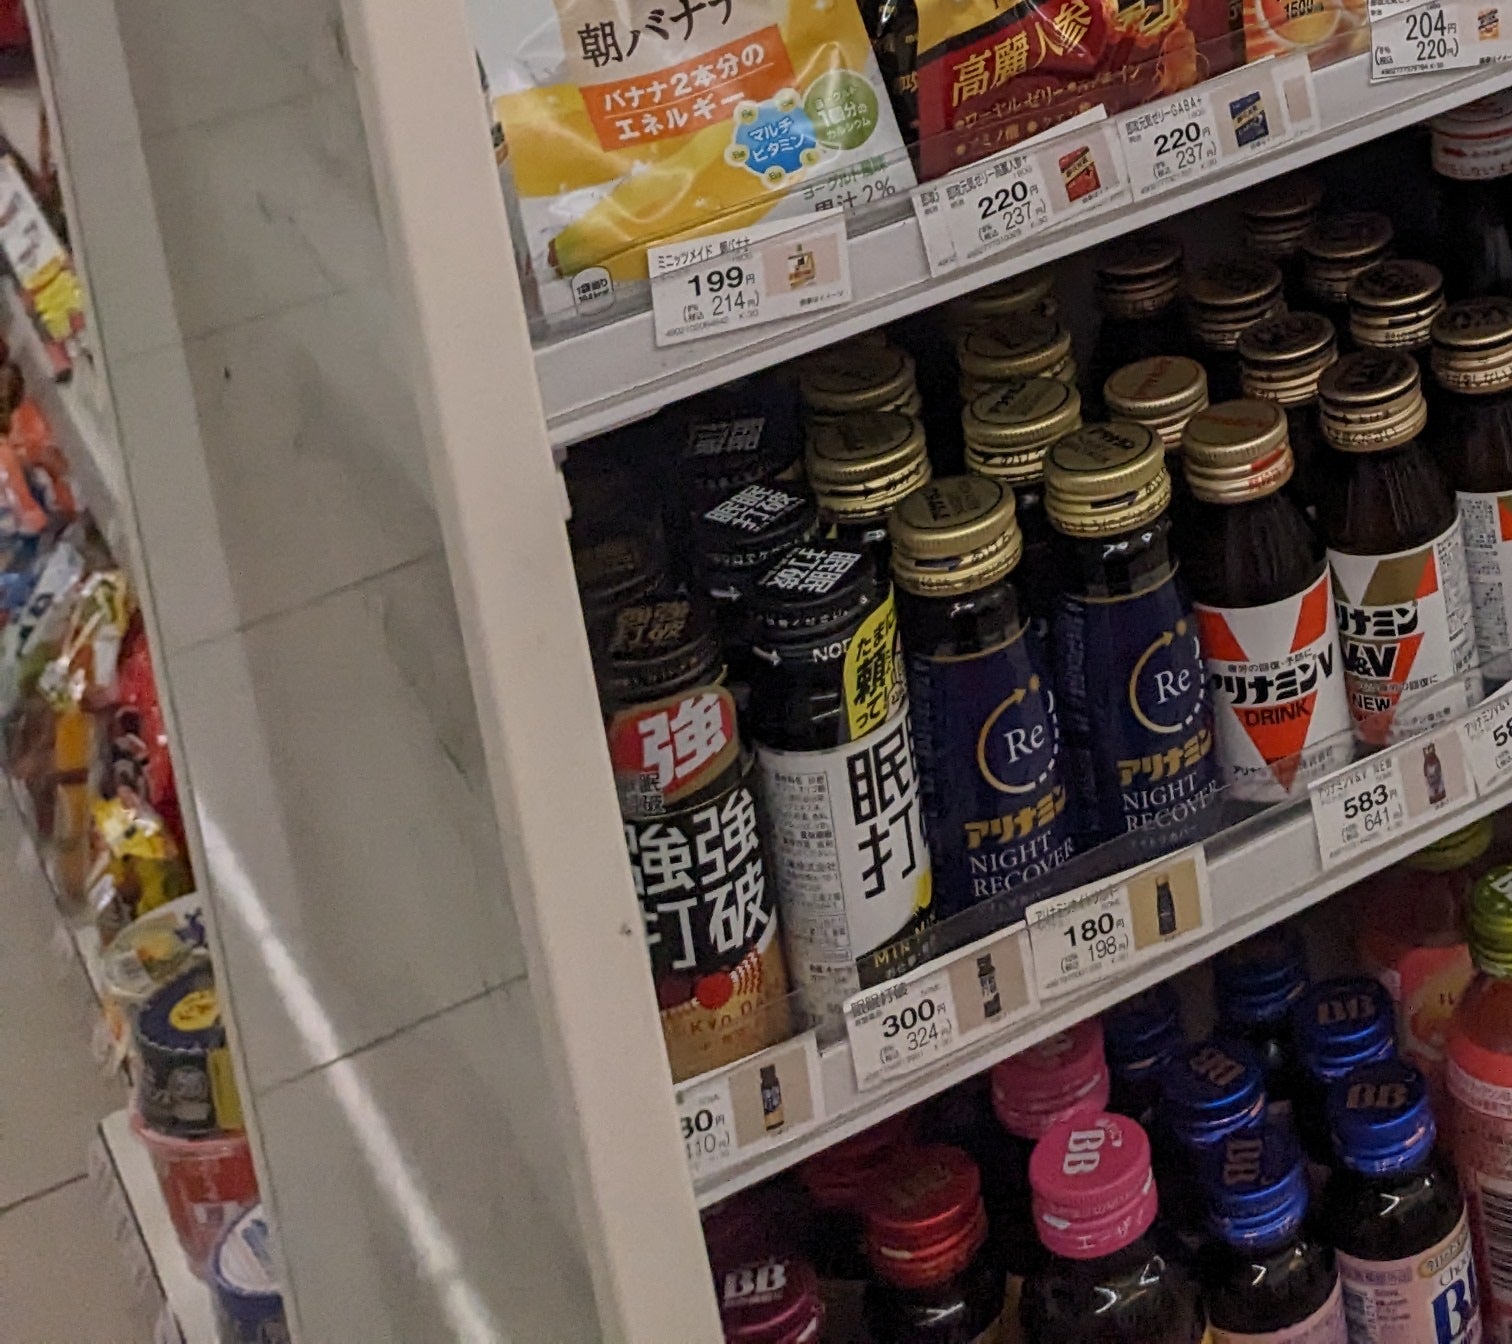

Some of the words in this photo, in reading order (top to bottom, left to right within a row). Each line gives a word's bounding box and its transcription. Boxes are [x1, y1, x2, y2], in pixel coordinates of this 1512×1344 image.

[614, 89, 748, 142] エネルギー
